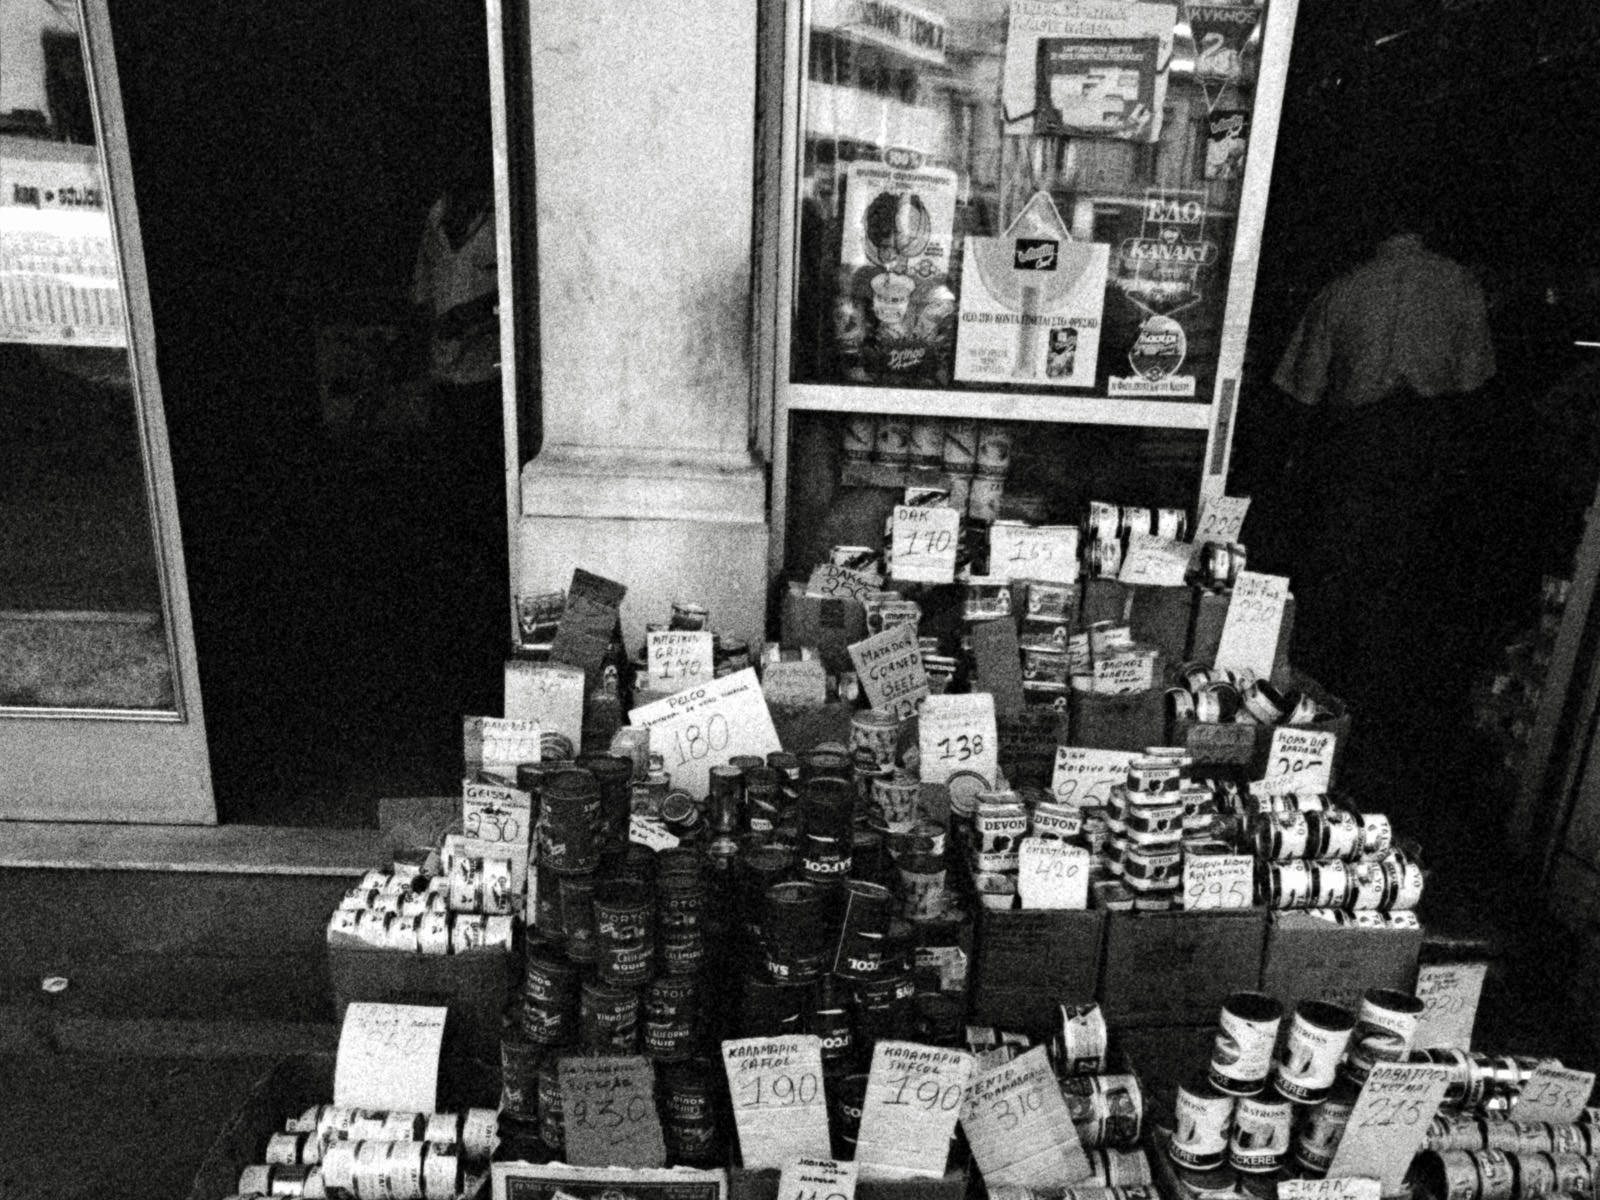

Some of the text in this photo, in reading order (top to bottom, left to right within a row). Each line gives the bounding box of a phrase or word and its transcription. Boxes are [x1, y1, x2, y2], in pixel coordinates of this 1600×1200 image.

[899, 509, 930, 522] DAK
[675, 713, 730, 768] 180
[937, 734, 984, 761] 138
[466, 812, 520, 843] 230
[984, 820, 1026, 831] DEVON
[1033, 814, 1077, 831] DEVON
[740, 1072, 818, 1108] 190
[881, 1075, 962, 1111] 190
